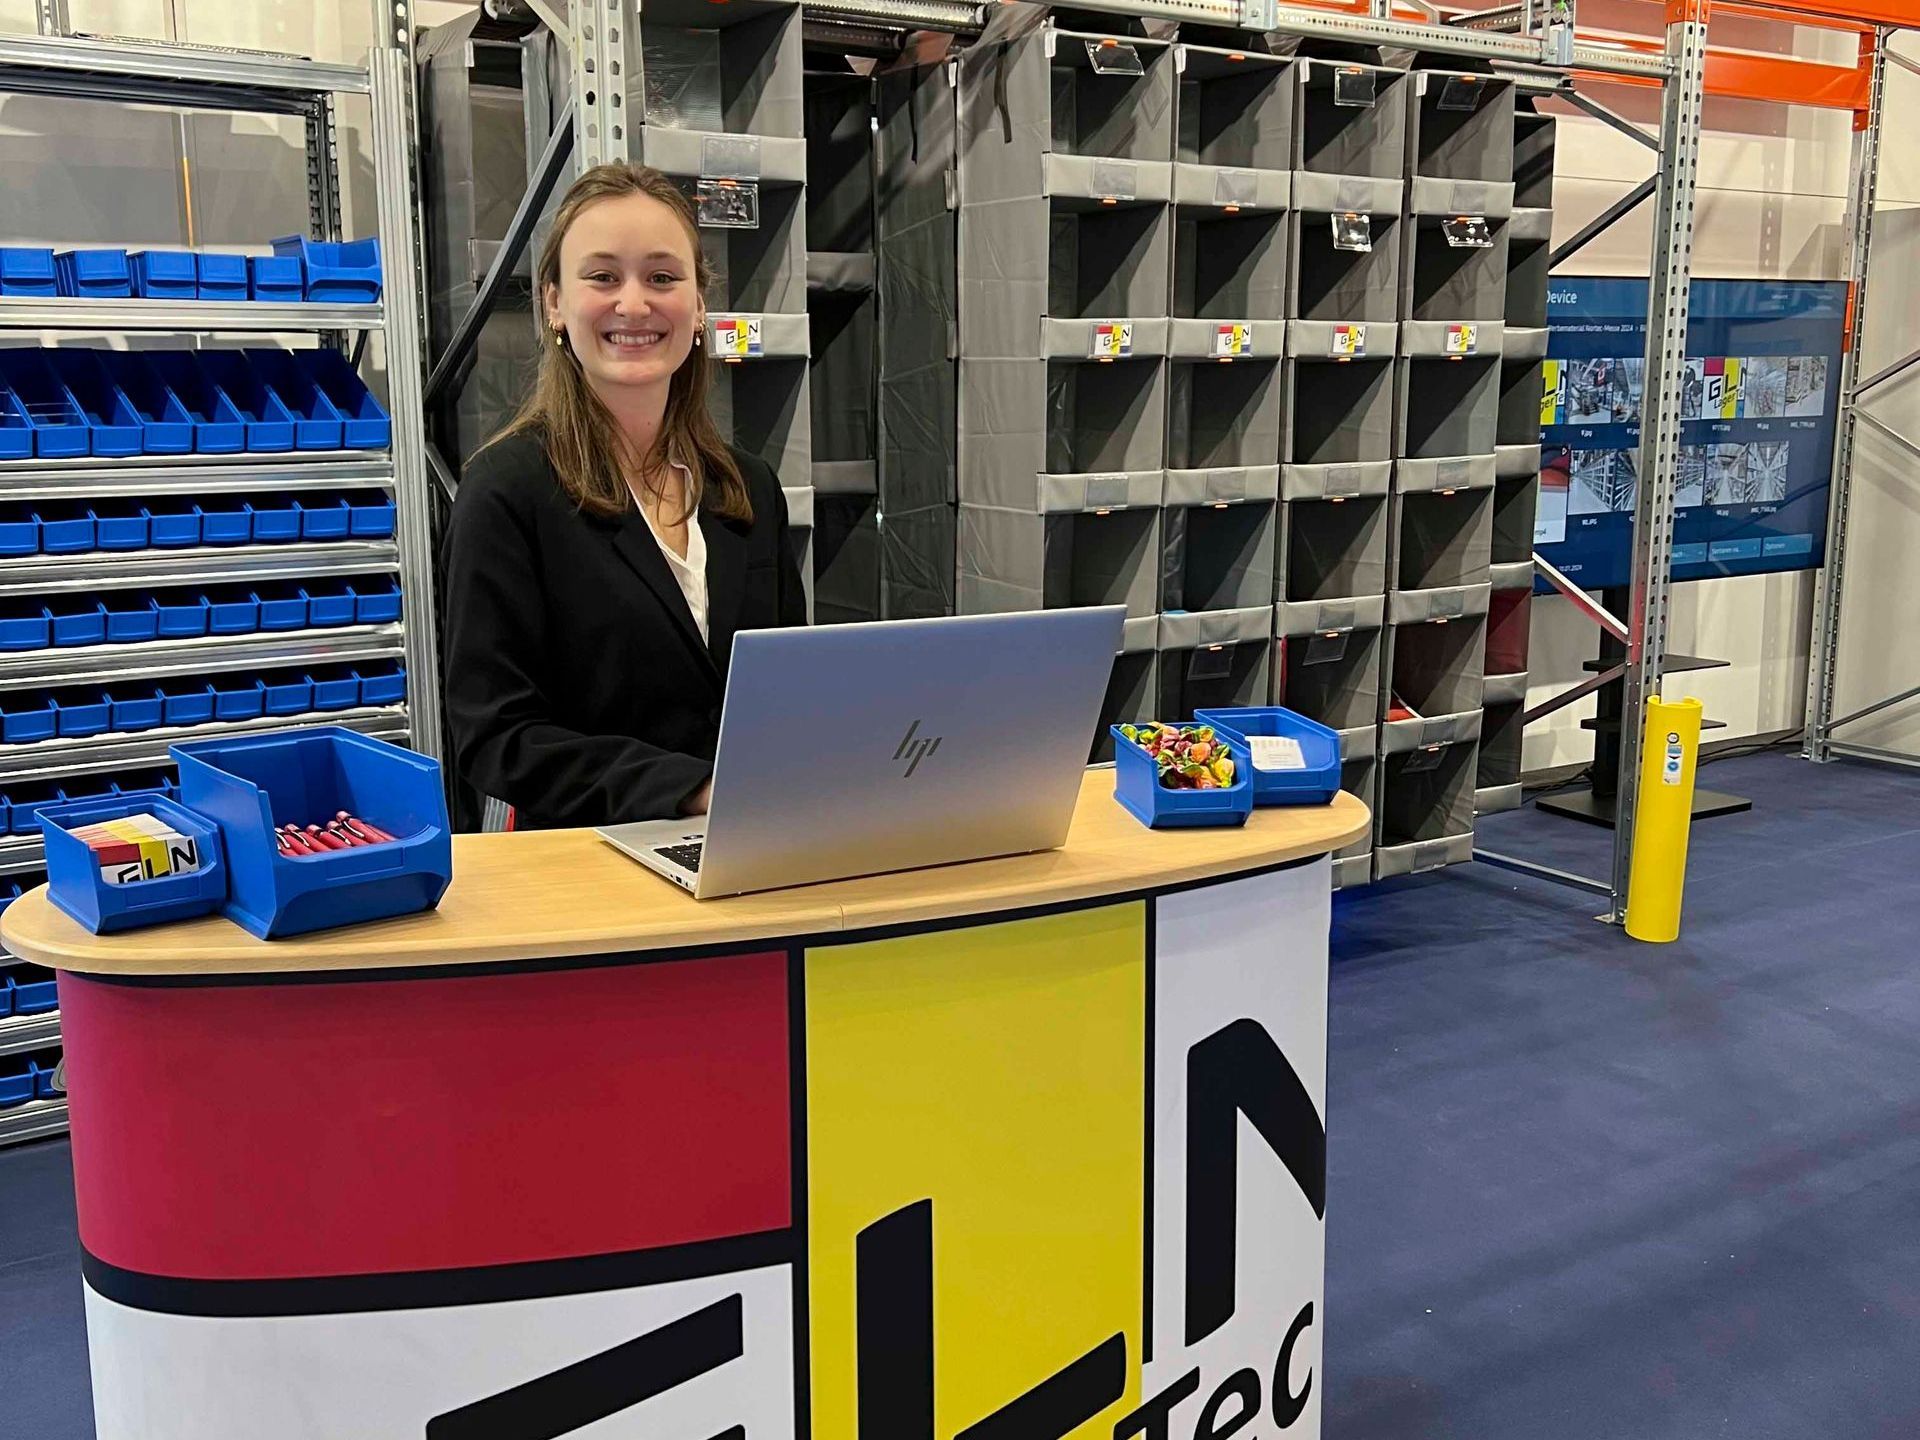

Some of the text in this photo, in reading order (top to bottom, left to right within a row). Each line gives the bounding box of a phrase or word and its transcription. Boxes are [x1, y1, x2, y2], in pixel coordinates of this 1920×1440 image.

[726, 322, 758, 344] GLN
[1103, 326, 1130, 346] GLN
[1224, 326, 1249, 345] GLN
[1340, 329, 1363, 345] GLN
[1453, 327, 1475, 344] GLN
[892, 719, 942, 778] hp
